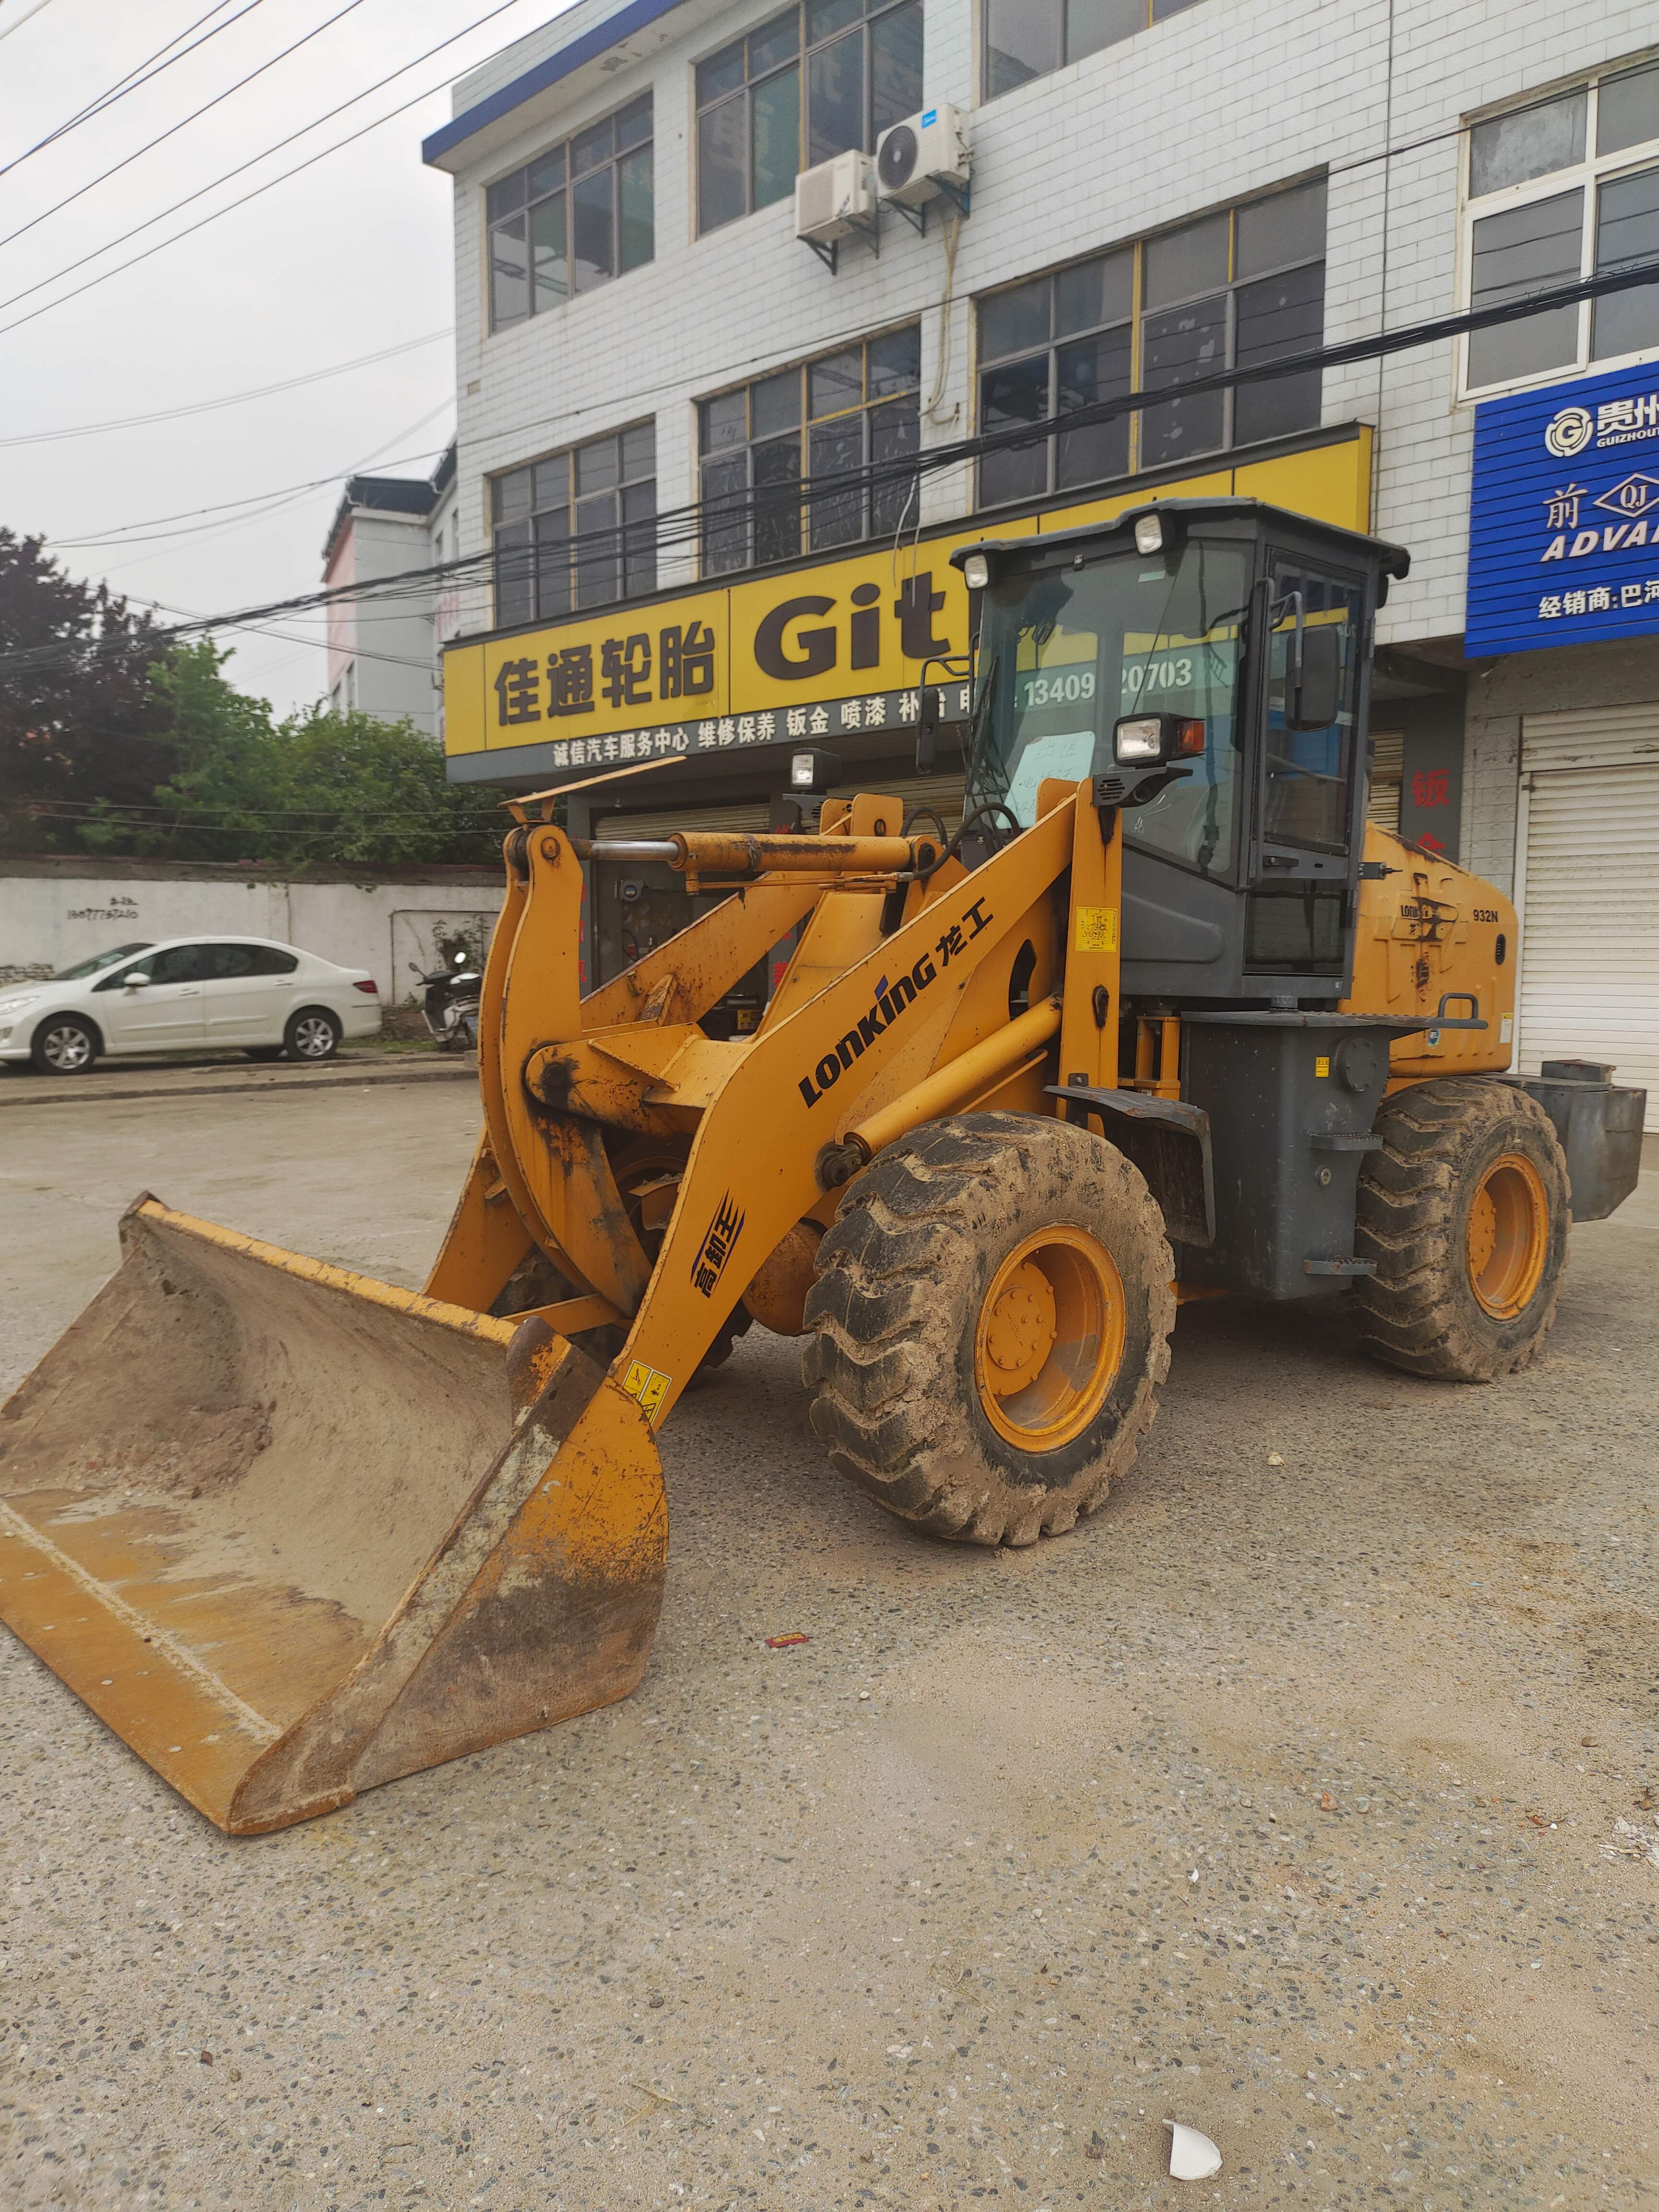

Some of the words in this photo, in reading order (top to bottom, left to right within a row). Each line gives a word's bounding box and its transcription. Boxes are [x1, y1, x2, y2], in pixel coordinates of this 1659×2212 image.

[1597, 395, 1659, 436] 贵州
[1542, 482, 1588, 529] 前
[1620, 484, 1647, 509] QJ
[1540, 520, 1659, 562] ADVA
[494, 620, 715, 727] 佳通轮胎
[553, 727, 689, 768] 诚信汽车服务中心
[697, 712, 776, 749] 维修保养
[786, 706, 830, 737] 钣金
[841, 697, 887, 730] 喷漆
[936, 896, 994, 967] 龙工
[1473, 909, 1499, 923] 932N
